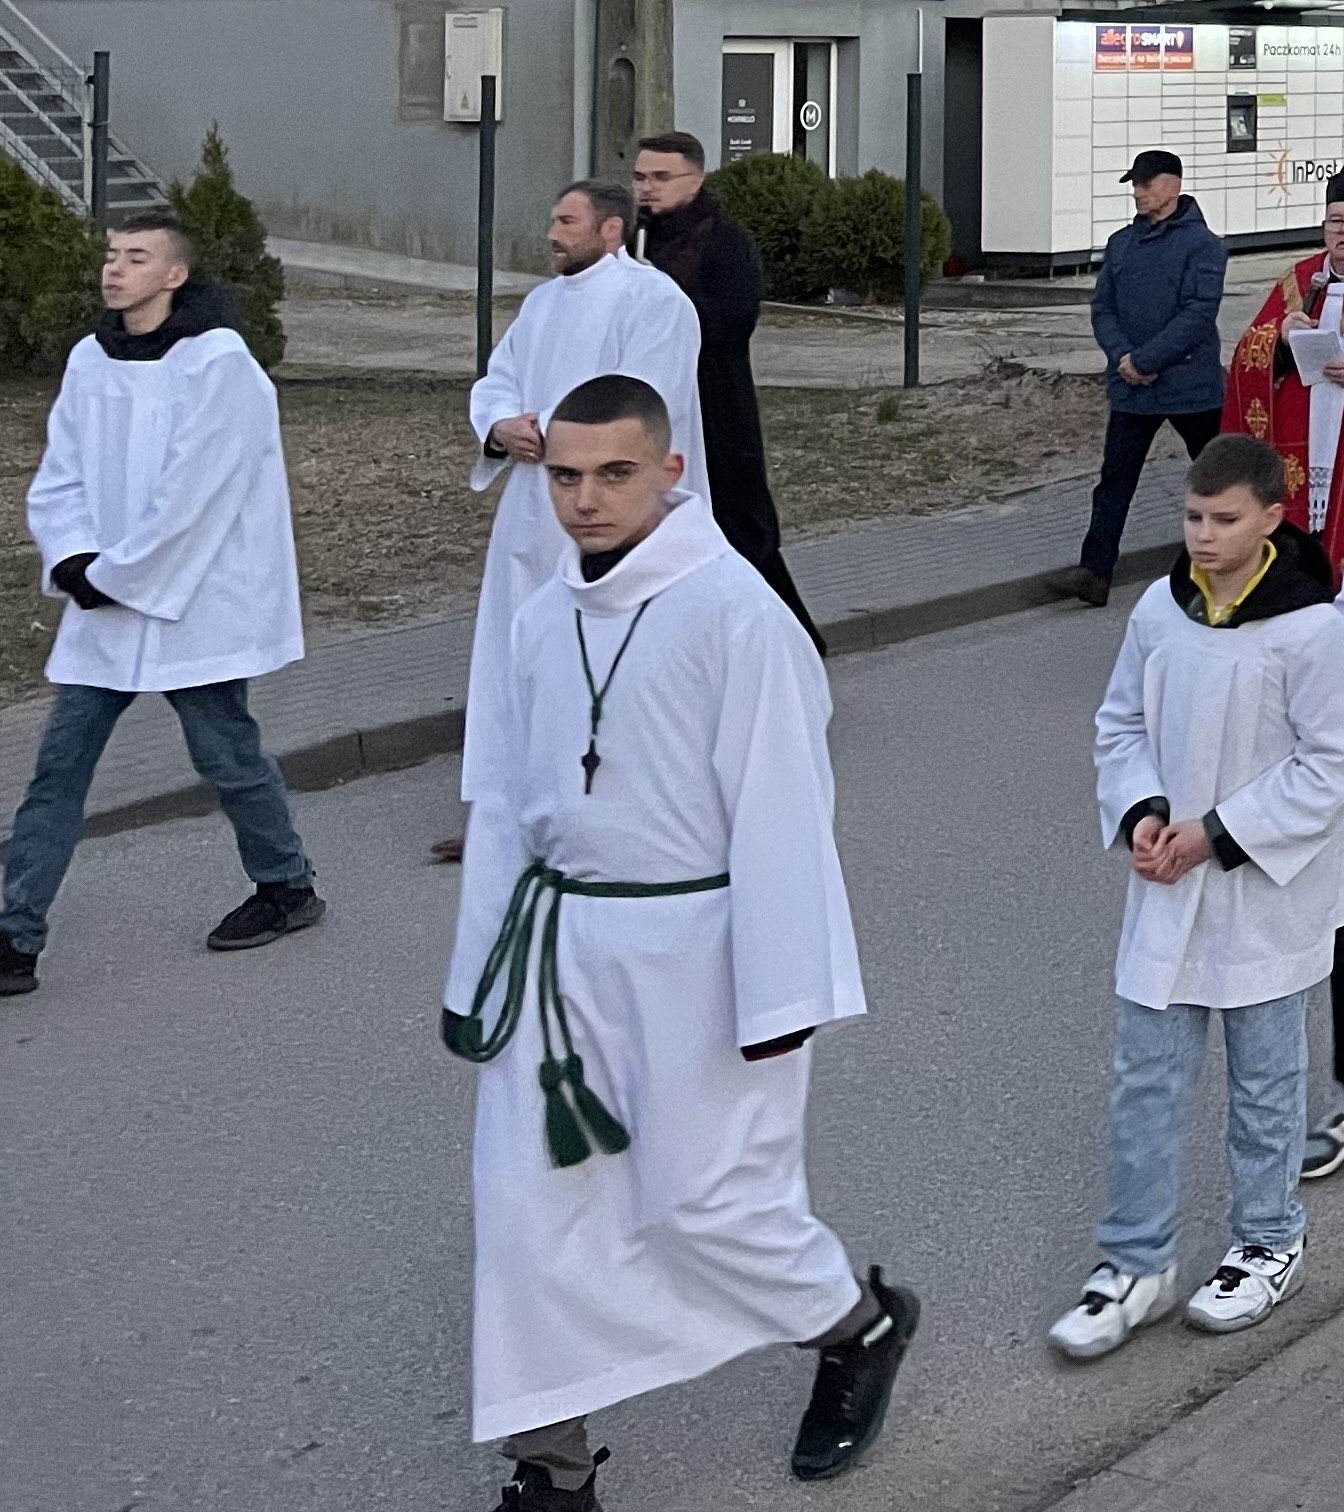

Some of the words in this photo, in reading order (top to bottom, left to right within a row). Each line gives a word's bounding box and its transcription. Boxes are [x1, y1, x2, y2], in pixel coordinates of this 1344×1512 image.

[1263, 42, 1320, 56] Paczkomat
[1323, 42, 1342, 56] 24h
[1292, 160, 1337, 183] InPost
